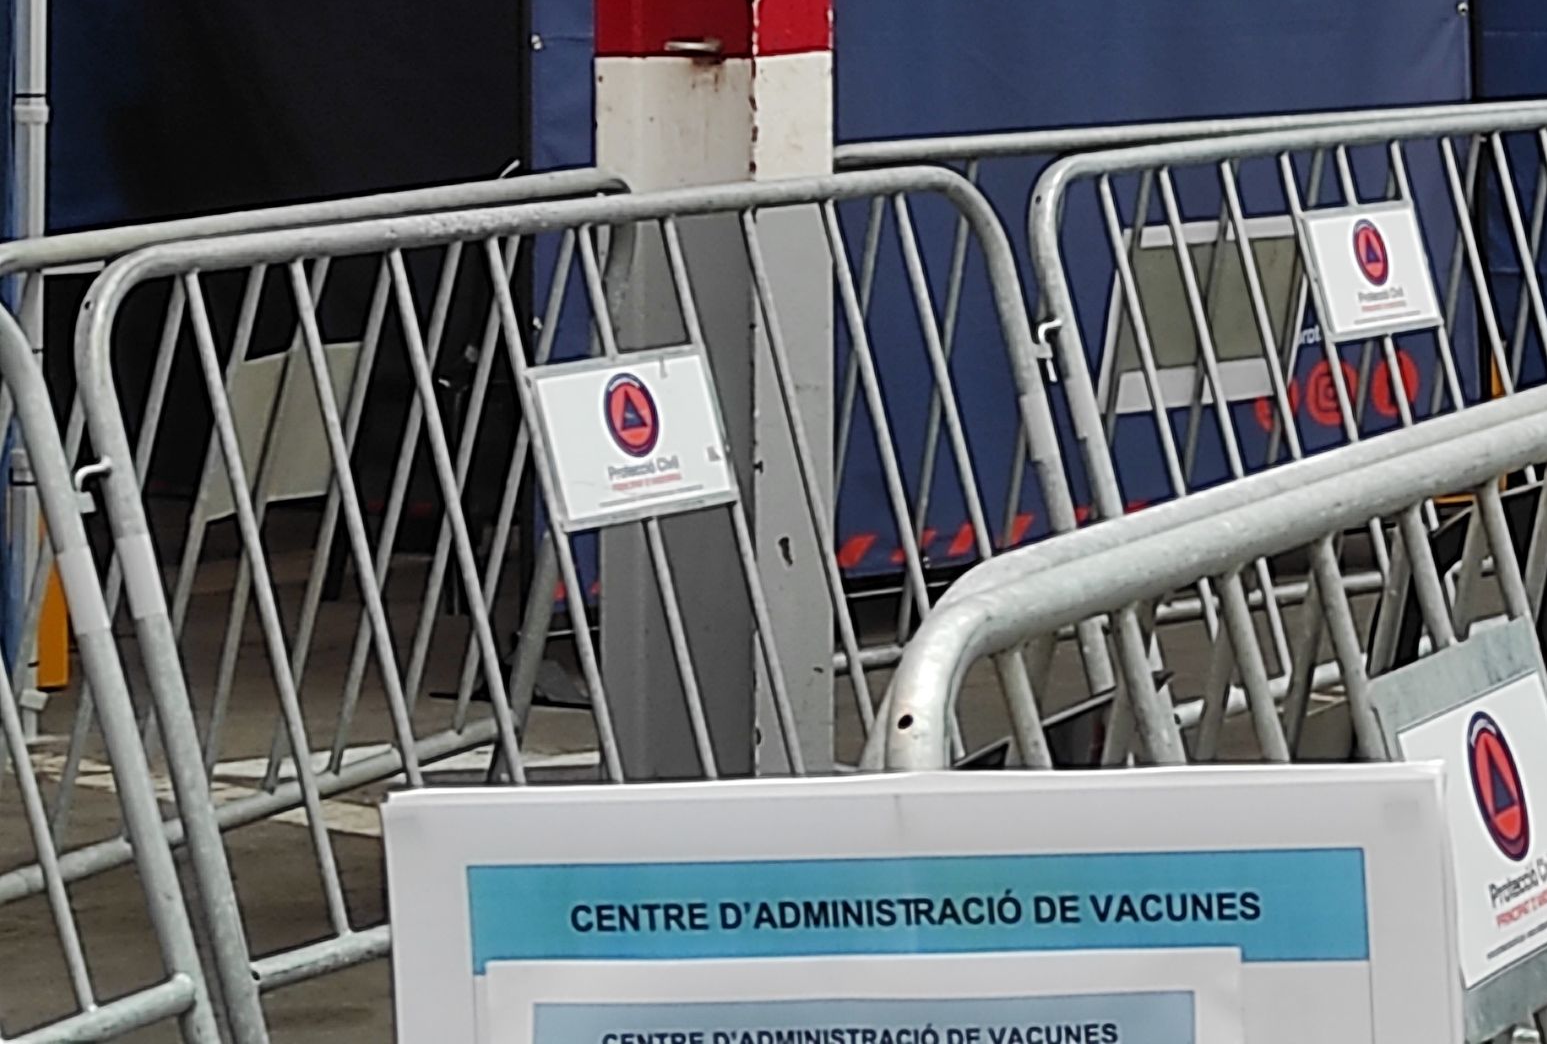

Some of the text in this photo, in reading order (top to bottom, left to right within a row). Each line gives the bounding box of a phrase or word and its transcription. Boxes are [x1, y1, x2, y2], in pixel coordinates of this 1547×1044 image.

[571, 903, 709, 932] CENTRE
[1033, 895, 1081, 923] DE
[1090, 892, 1261, 923] VACUNES
[988, 1022, 1117, 1044] VACUNES
